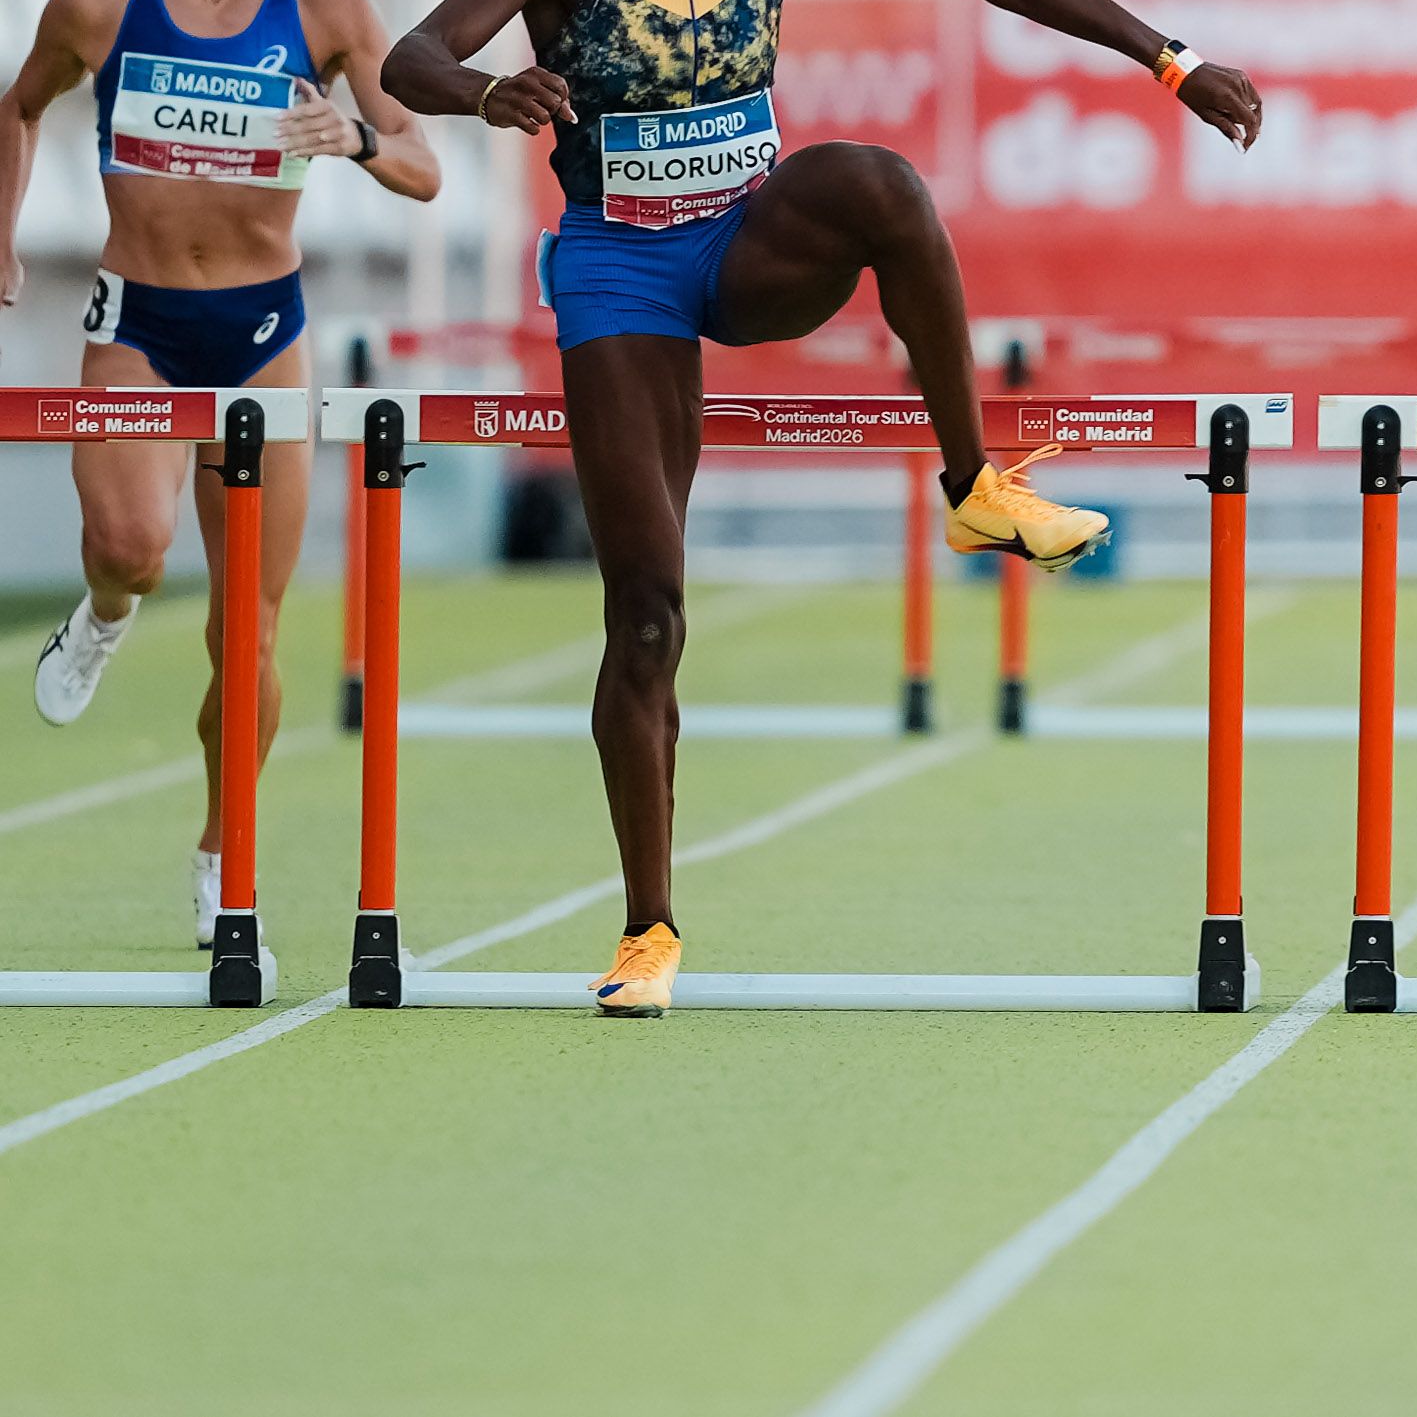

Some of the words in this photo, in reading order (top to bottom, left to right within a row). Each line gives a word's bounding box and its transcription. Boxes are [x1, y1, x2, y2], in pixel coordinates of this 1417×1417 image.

[175, 71, 262, 102] MADRID
[154, 105, 248, 137] CARLI
[665, 111, 746, 143] MADRID
[607, 142, 776, 181] FOLORUNSO
[671, 186, 748, 211] Comuni
[84, 275, 109, 332] 8
[75, 400, 173, 414] Comunidad
[763, 410, 847, 424] Continental
[848, 411, 880, 424] Tour
[1055, 408, 1154, 423] Comunidad
[75, 418, 100, 433] de
[104, 418, 172, 433] Madrid
[505, 410, 566, 432] MAD
[1055, 427, 1081, 442] de
[1085, 427, 1154, 442] Madrid
